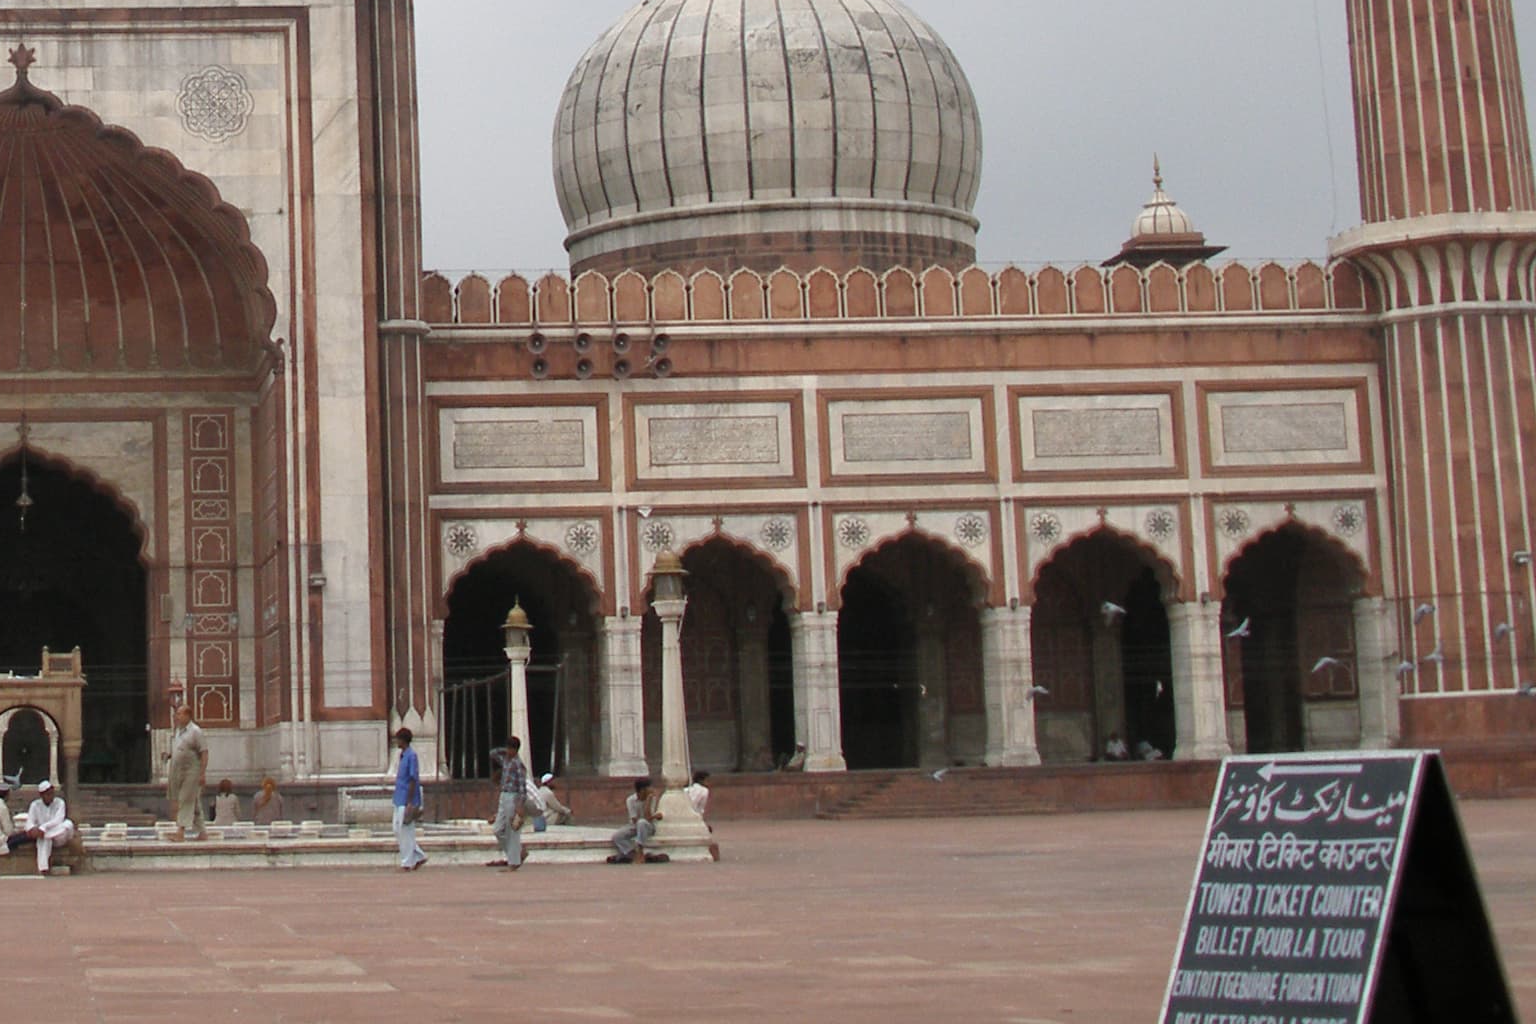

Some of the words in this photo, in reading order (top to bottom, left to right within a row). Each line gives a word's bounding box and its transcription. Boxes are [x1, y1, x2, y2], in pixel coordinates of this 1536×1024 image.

[1207, 831, 1254, 872] मीनार
[1256, 831, 1319, 871] टिकिट
[1318, 837, 1396, 872] काउन्टर
[1198, 882, 1252, 916] TOWER
[1253, 884, 1312, 917] TICKET
[1311, 885, 1383, 918] COUNTER
[1195, 927, 1252, 955] BILLET
[1251, 927, 1294, 957] POUR
[1292, 928, 1316, 958] LA
[1319, 928, 1366, 958] TOUR
[1325, 973, 1363, 1003] TURM
